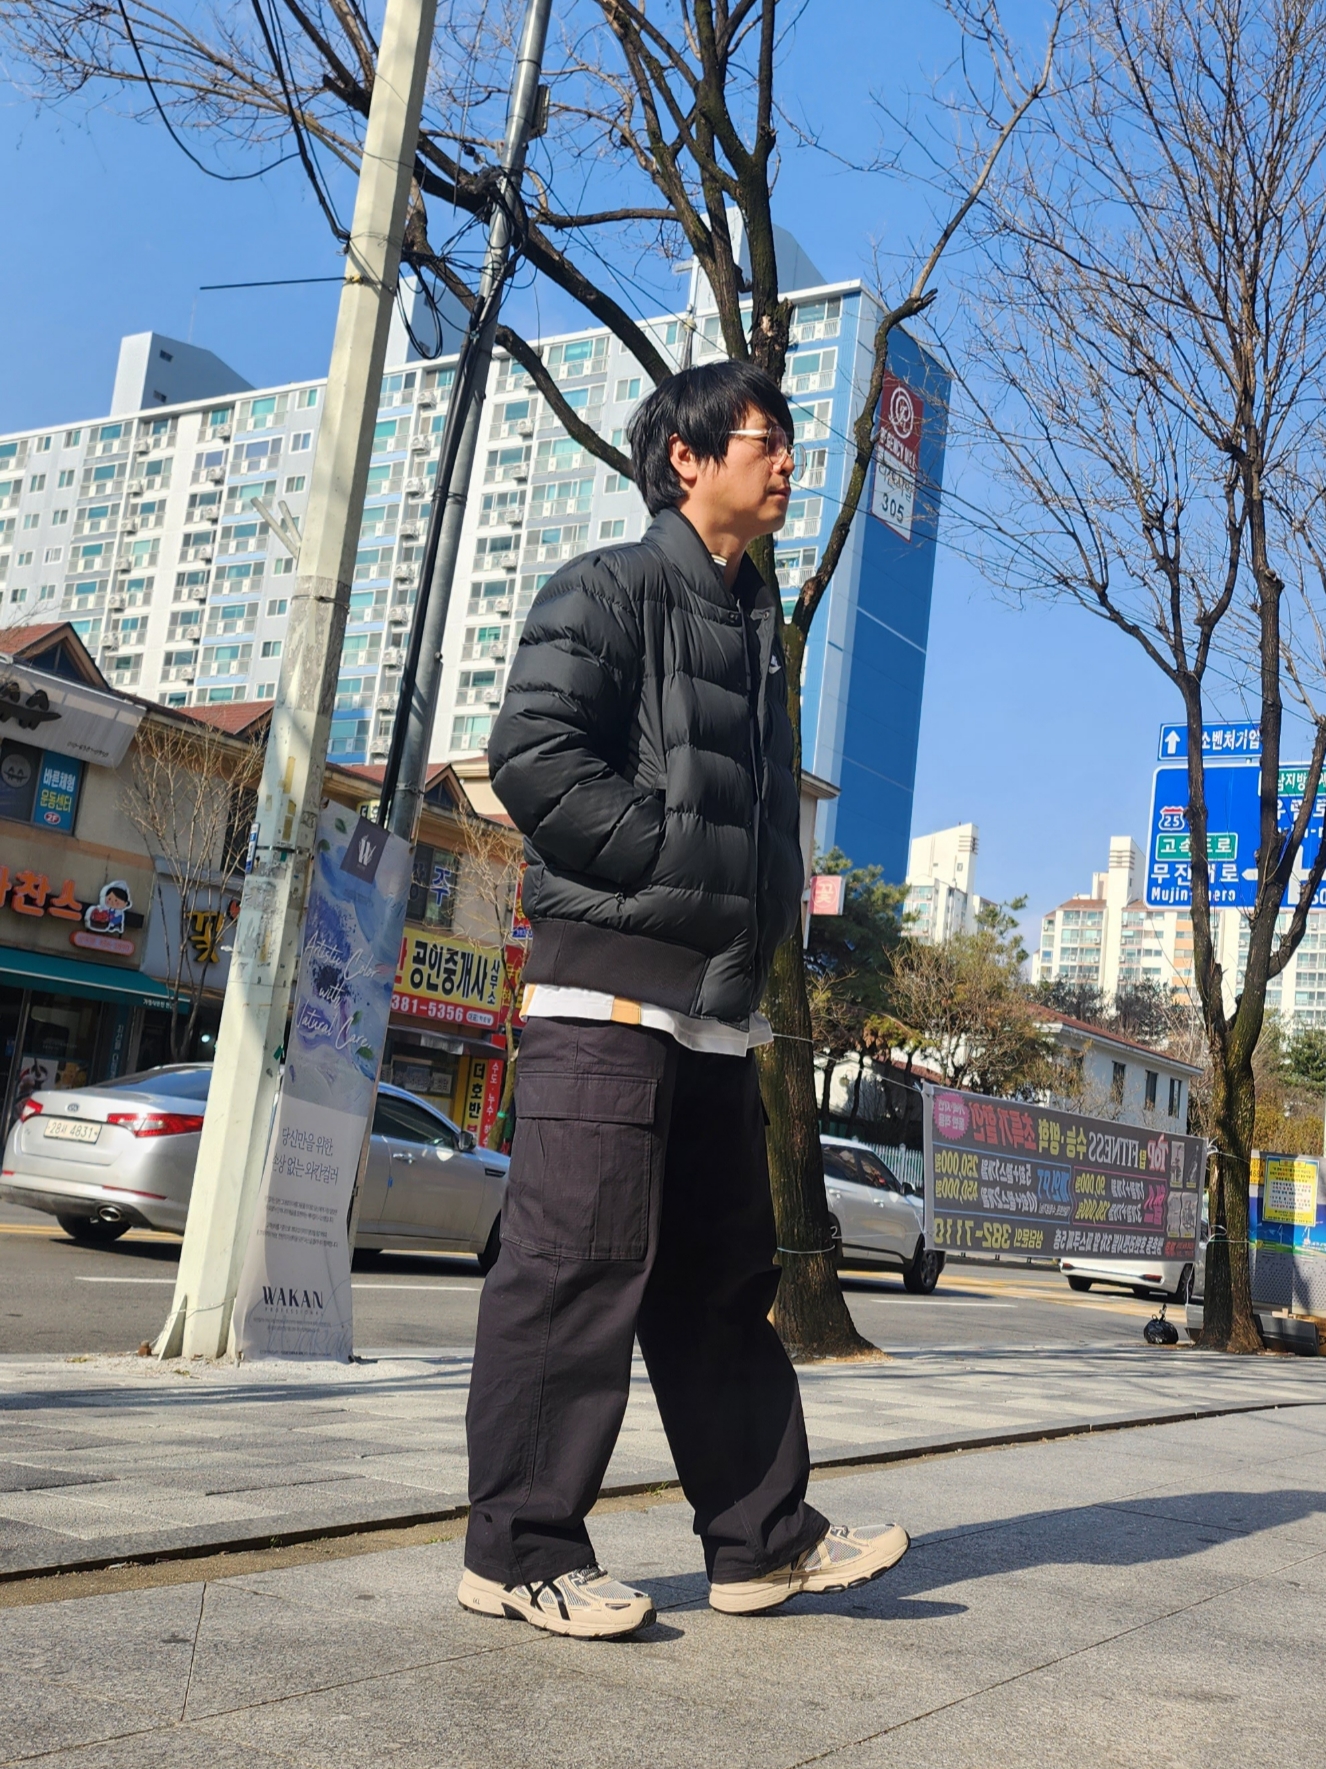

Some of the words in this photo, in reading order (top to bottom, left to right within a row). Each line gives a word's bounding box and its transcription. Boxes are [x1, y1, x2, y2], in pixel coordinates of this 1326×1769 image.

[882, 493, 904, 524] 305
[46, 813, 58, 822] 2F
[1164, 815, 1180, 827] 25
[343, 948, 380, 981] Color
[410, 939, 487, 1002] 공인중개사
[487, 957, 501, 1006] 사무소
[318, 983, 342, 1010] with
[282, 1126, 316, 1152] 당신만을
[286, 1157, 305, 1177] 없는
[262, 1286, 324, 1309] WAKAN
